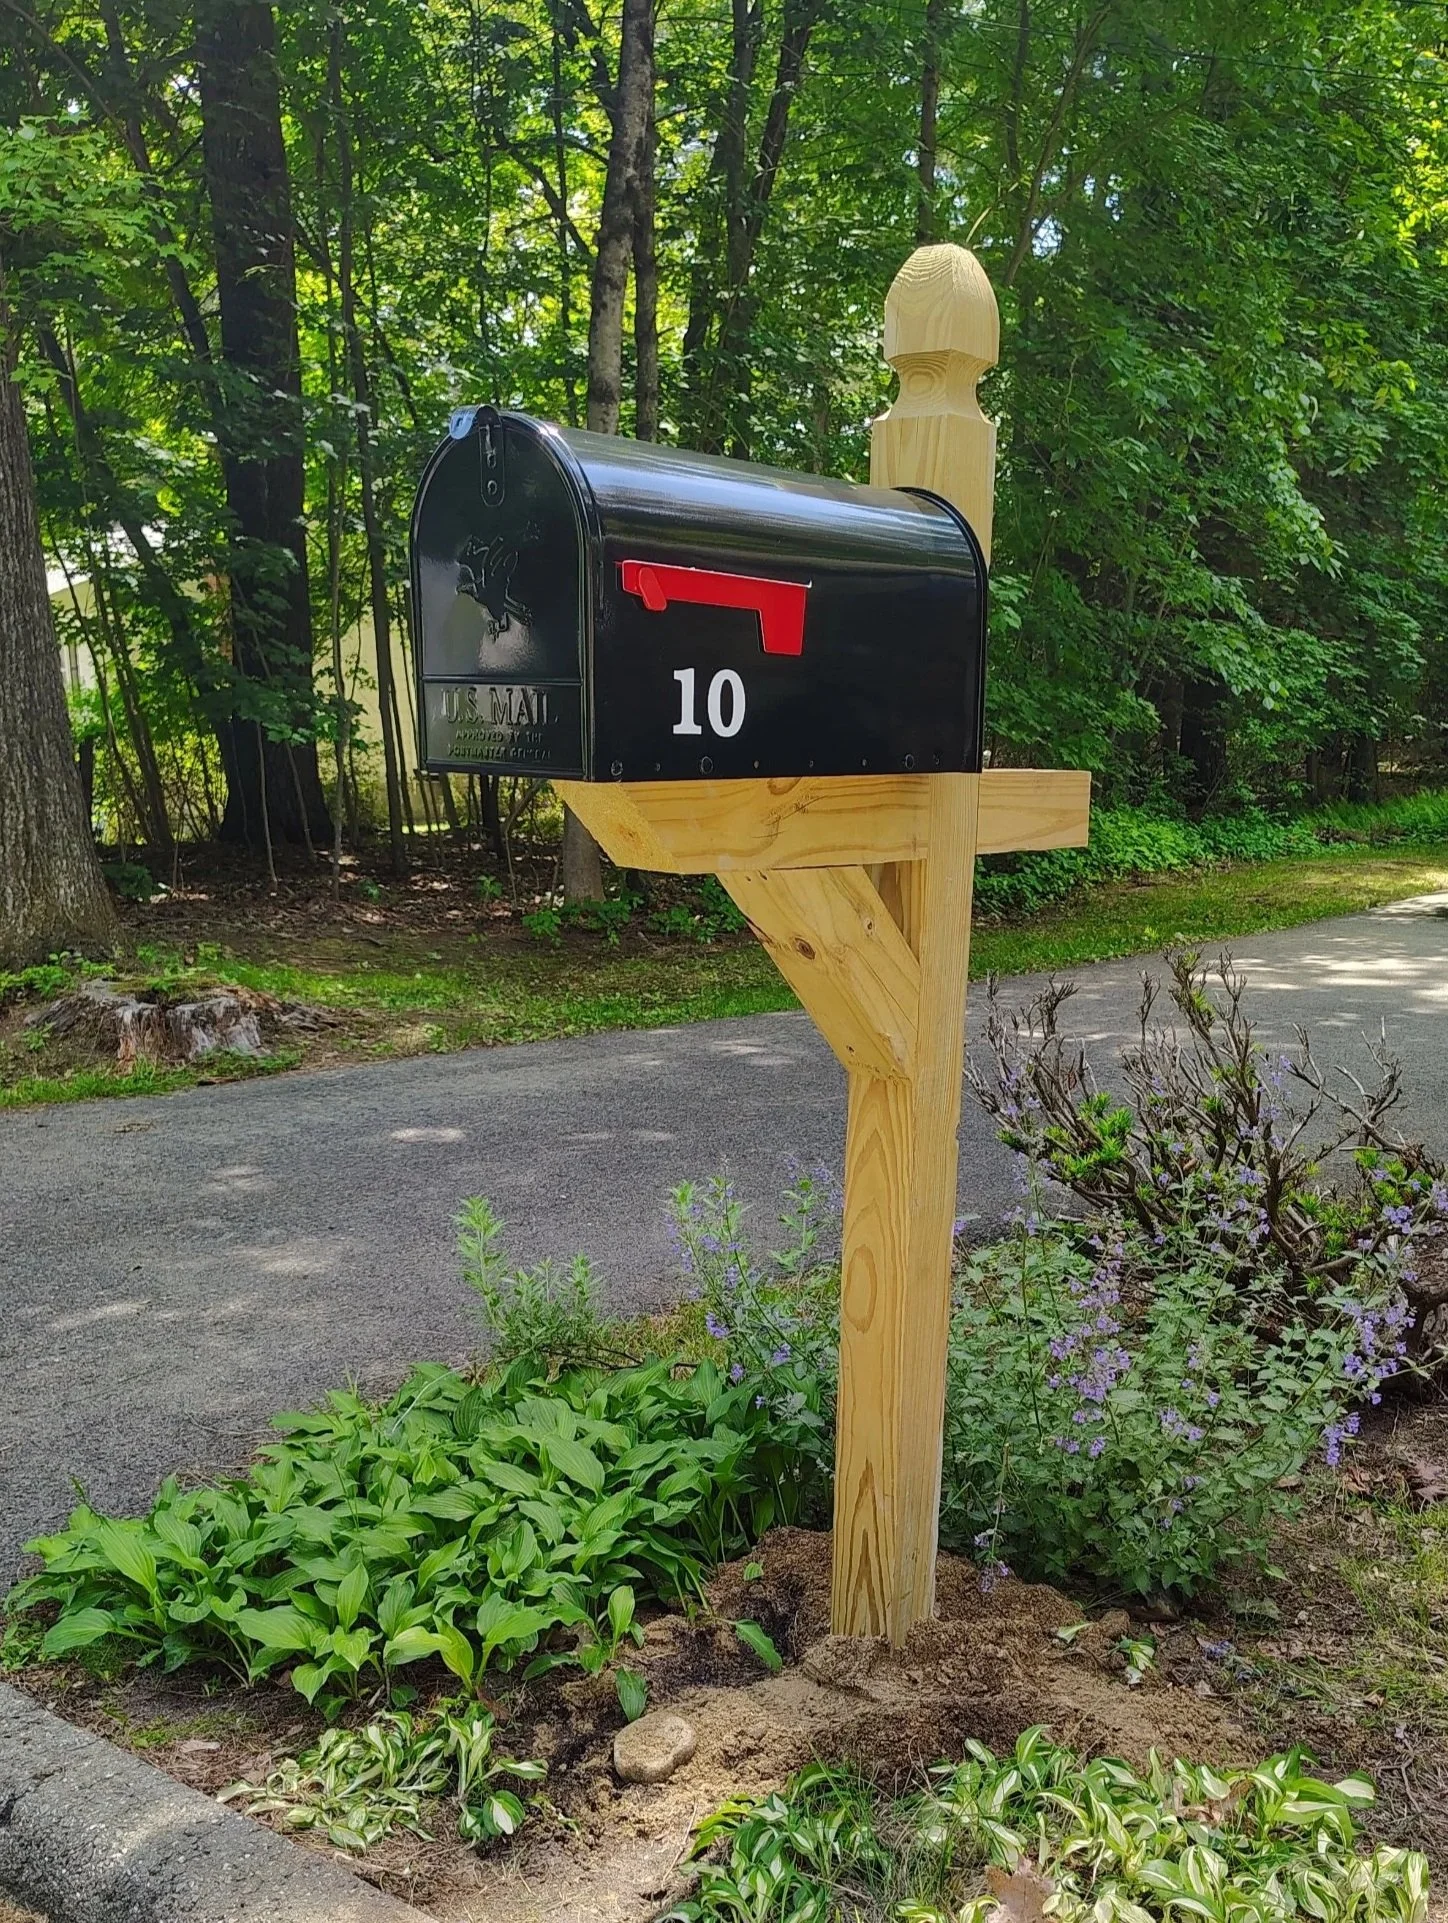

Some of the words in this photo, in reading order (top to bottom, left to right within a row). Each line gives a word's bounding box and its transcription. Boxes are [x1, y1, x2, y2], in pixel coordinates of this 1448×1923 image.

[441, 687, 484, 724] U.S.
[489, 687, 559, 726] MAIL
[672, 667, 746, 738] 10
